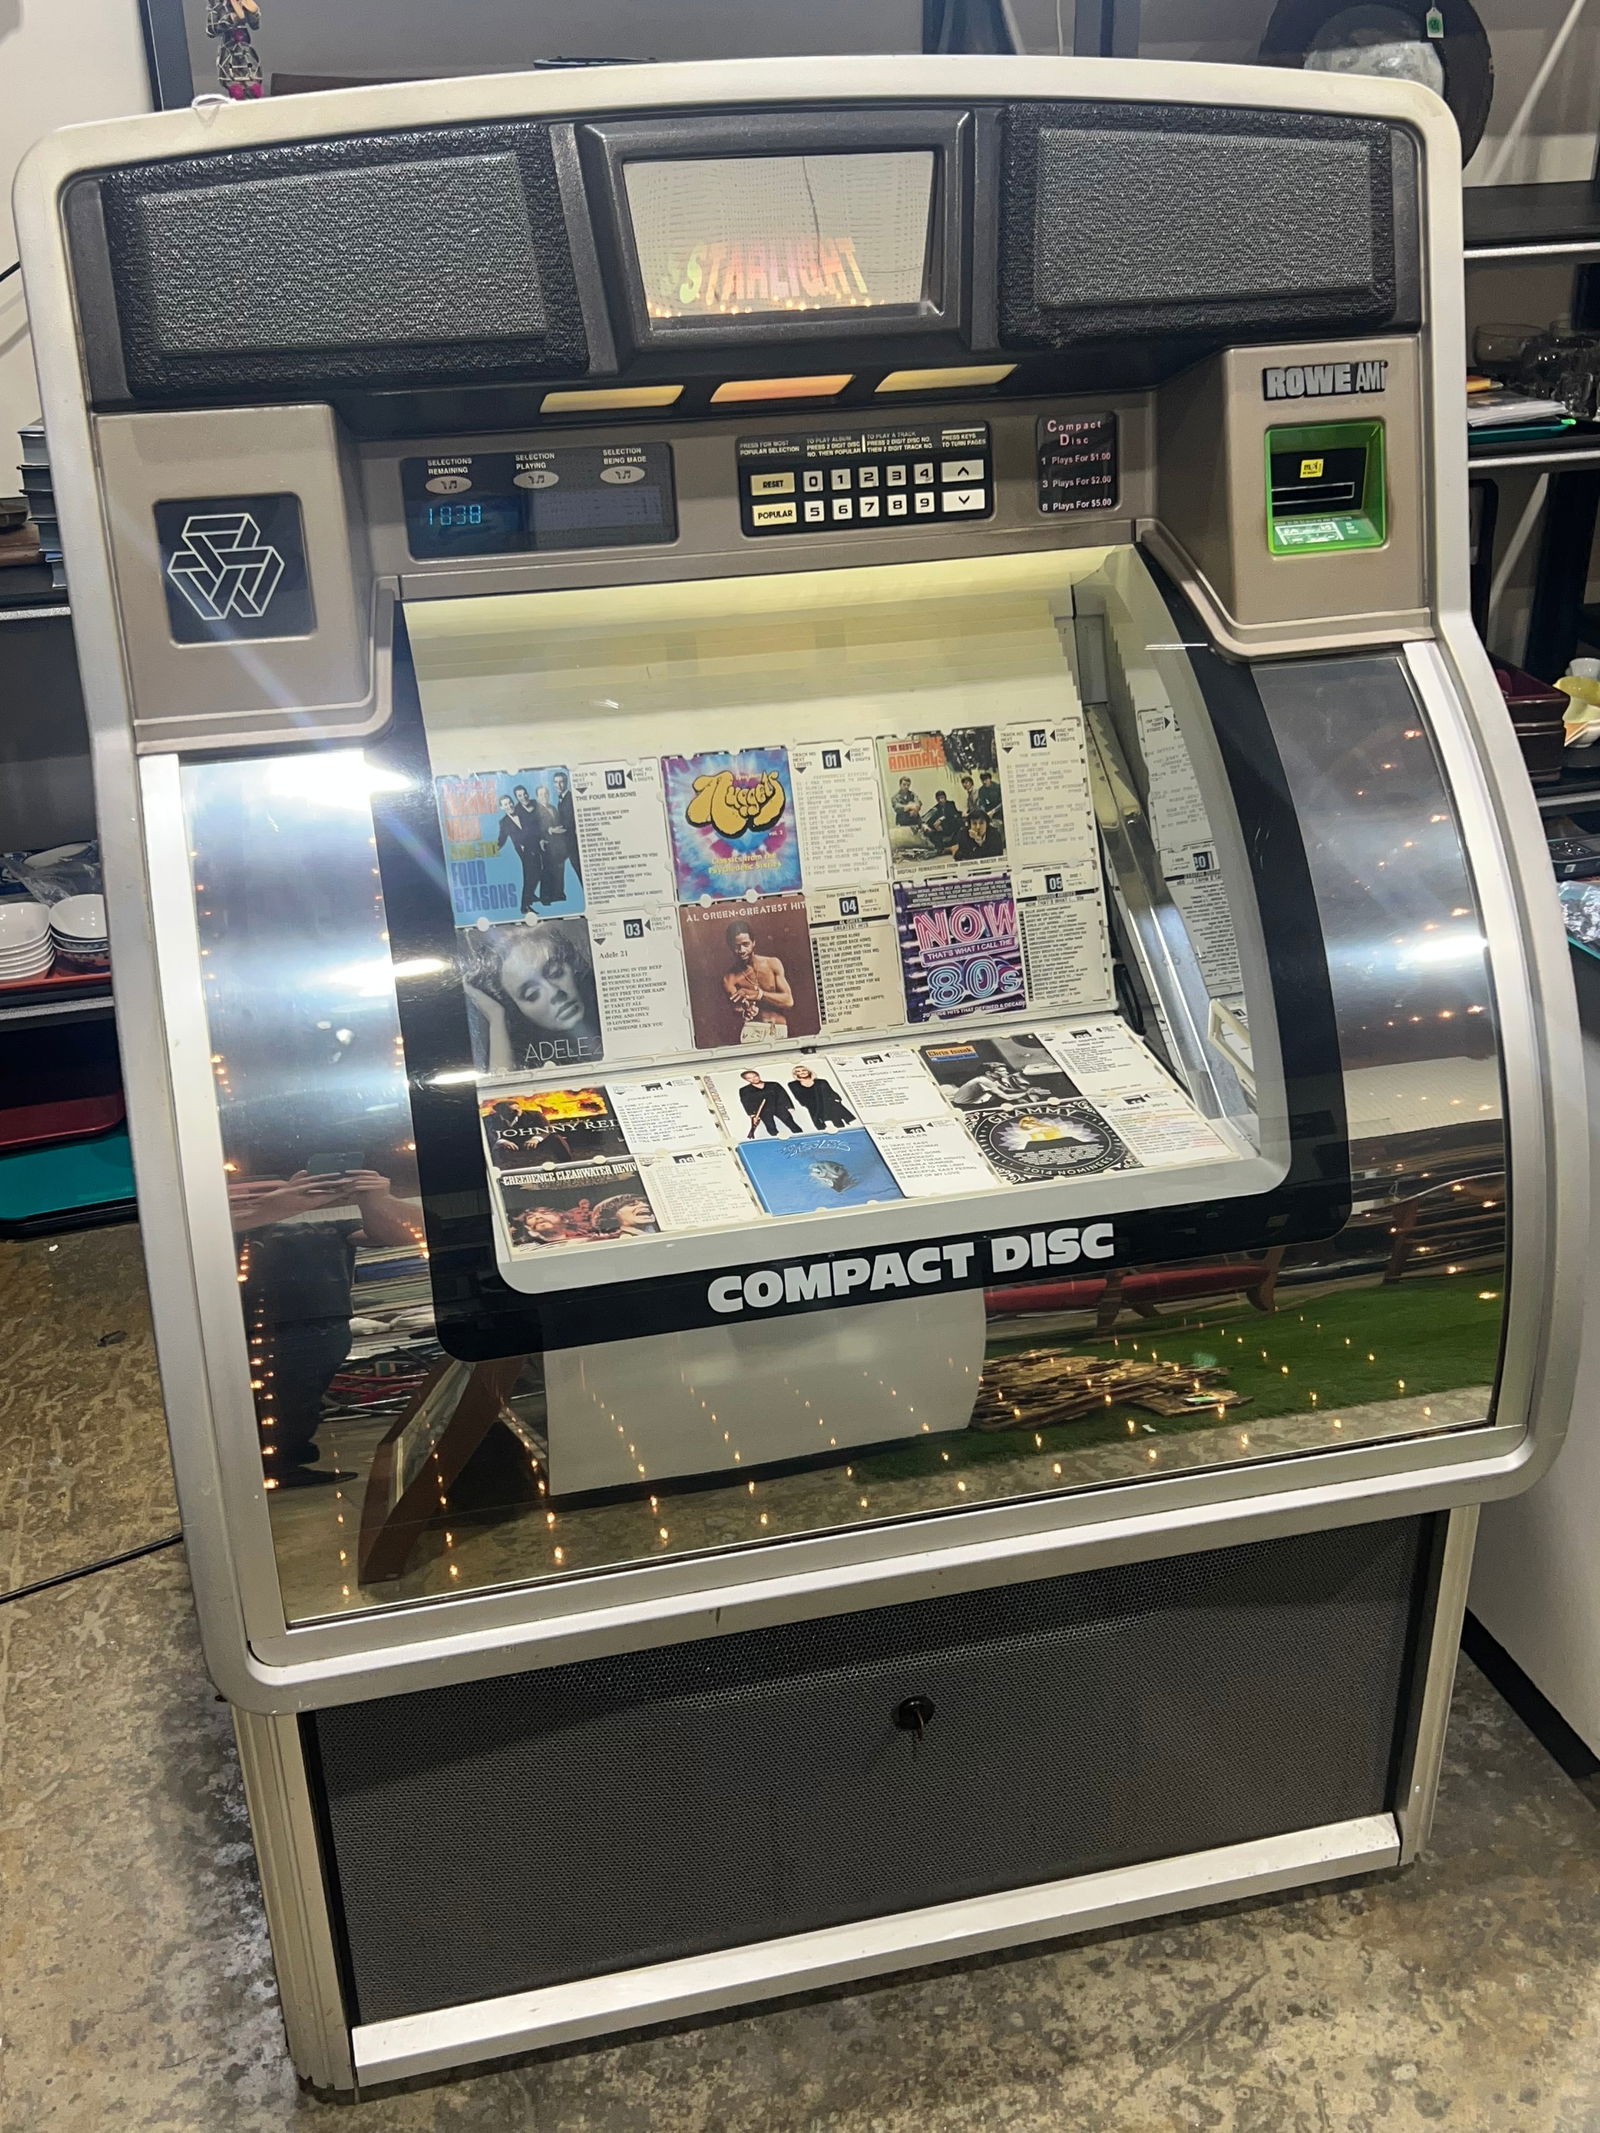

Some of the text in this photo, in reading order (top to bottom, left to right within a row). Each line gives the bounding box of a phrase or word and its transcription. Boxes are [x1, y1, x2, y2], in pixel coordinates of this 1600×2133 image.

[1266, 363, 1351, 399] ROWE
[1047, 420, 1101, 432] Compact
[967, 438, 986, 446] PAGES
[1060, 434, 1089, 446] Disc
[603, 448, 642, 456] SELECTION
[740, 446, 800, 456] POPULAR SELECTION
[834, 448, 861, 456] POPULAR
[427, 457, 472, 466] SELECTIONS
[515, 453, 555, 461] SELECTION
[603, 455, 647, 465] BEING MADE
[1052, 456, 1073, 465] Plays
[1075, 454, 1088, 462] For
[1090, 452, 1111, 462] $1.00
[428, 467, 469, 475] REMAINING
[516, 462, 547, 470] PLAYING
[863, 472, 874, 482] 2
[892, 470, 902, 480] 3
[920, 468, 929, 478] 4
[763, 480, 784, 489] RESET
[809, 476, 818, 487] 0
[837, 475, 844, 484] 1
[1042, 476, 1112, 488] 3 Plays For $2.00
[864, 502, 874, 512] 7
[892, 500, 902, 510] 8
[920, 498, 930, 508] 9
[1053, 502, 1074, 511] Plays
[1076, 500, 1090, 508] For
[1091, 498, 1112, 508] $5.00
[810, 507, 820, 517] 5
[838, 504, 848, 514] 6
[758, 510, 793, 520] POPULAR
[825, 754, 838, 768] 01
[607, 772, 623, 787] 00
[607, 791, 637, 799] SEASONS
[451, 860, 487, 887] FOUR
[455, 883, 518, 913] SEASONS
[842, 900, 857, 913] 04
[686, 913, 700, 922] AL
[626, 922, 641, 937] 03
[913, 903, 1016, 950] NOW
[927, 950, 954, 960] THAT'S
[954, 946, 977, 955] WHAT
[981, 941, 998, 950] CALL
[999, 939, 1013, 947] THE
[927, 957, 1022, 1008] 80s
[524, 1036, 590, 1062] ADELE
[988, 1106, 1077, 1124] GRAMMY
[496, 1119, 620, 1139] JOHNNY REI
[1023, 1156, 1114, 1176] 2014 NOMINEES
[503, 1172, 556, 1186] CREEDENCE
[556, 1166, 612, 1181] CLEARWATER
[613, 1162, 638, 1174] REVIV
[707, 1223, 1115, 1314] COMPACT DISC
